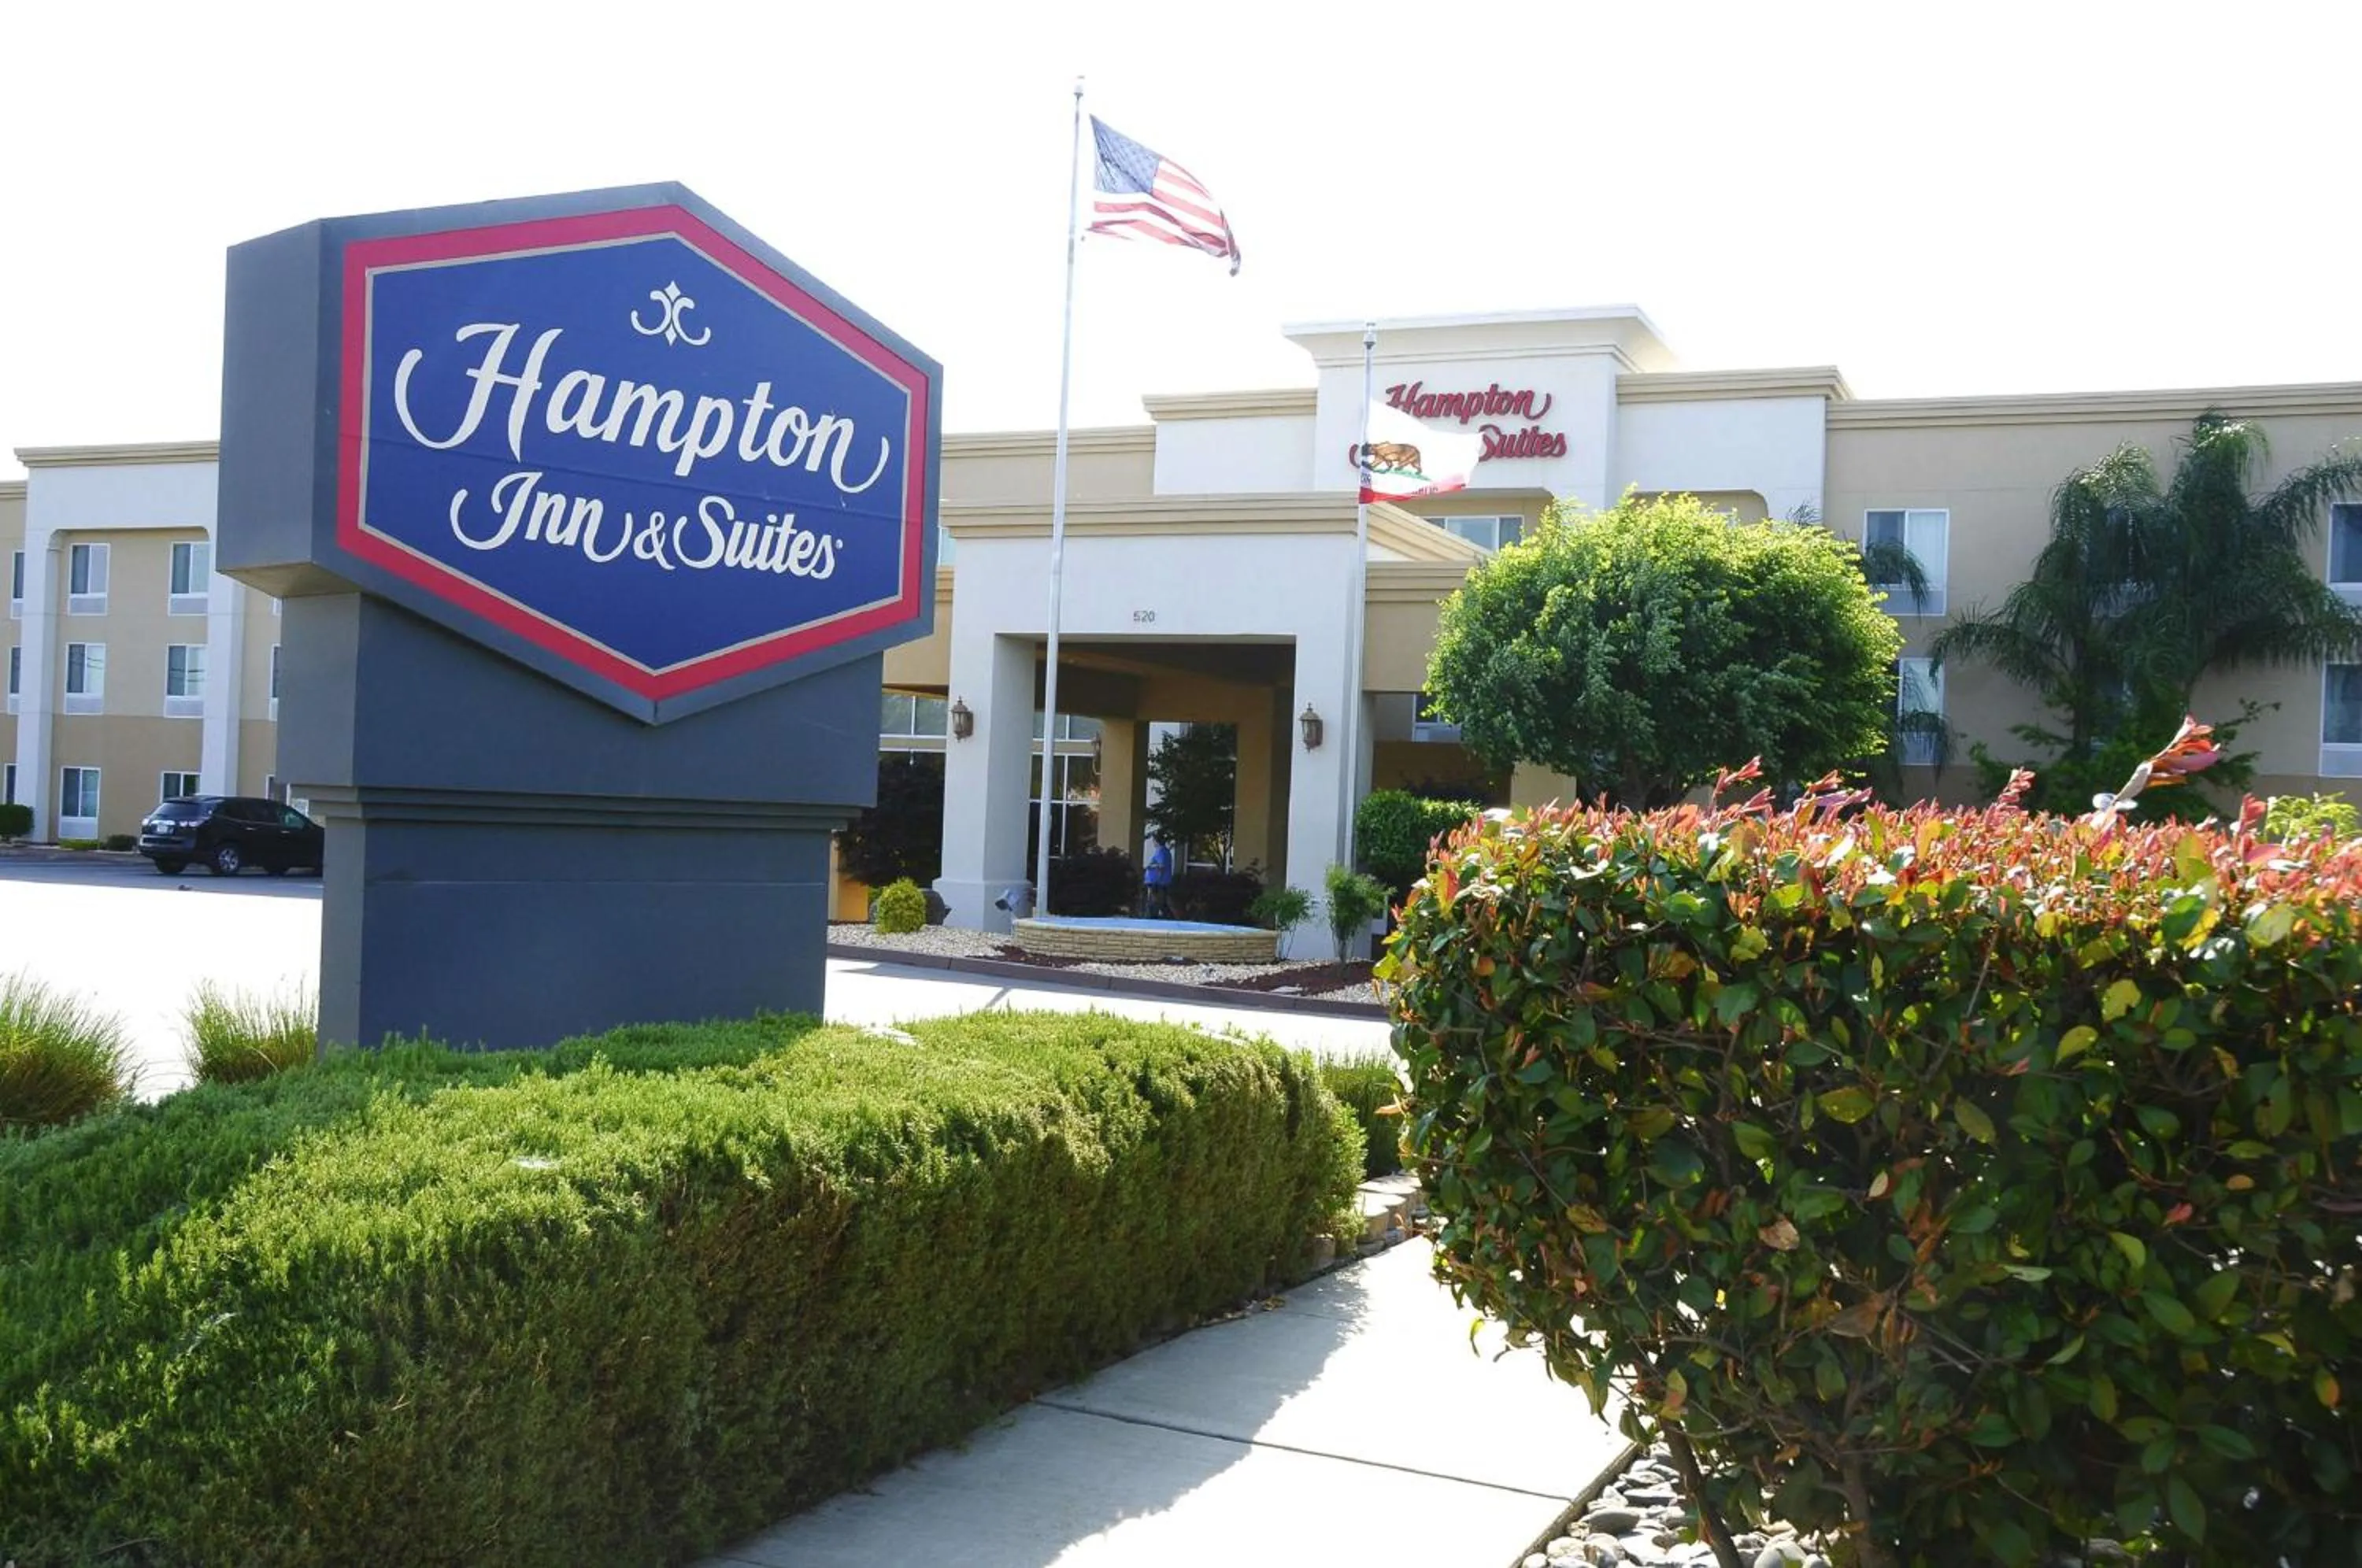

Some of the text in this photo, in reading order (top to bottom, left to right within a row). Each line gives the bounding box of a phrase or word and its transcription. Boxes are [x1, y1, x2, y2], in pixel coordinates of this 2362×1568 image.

[394, 323, 890, 494] Hampton
[1386, 381, 1552, 424] Hampton
[450, 472, 836, 580] Inn & Suites
[1133, 610, 1155, 623] 520
